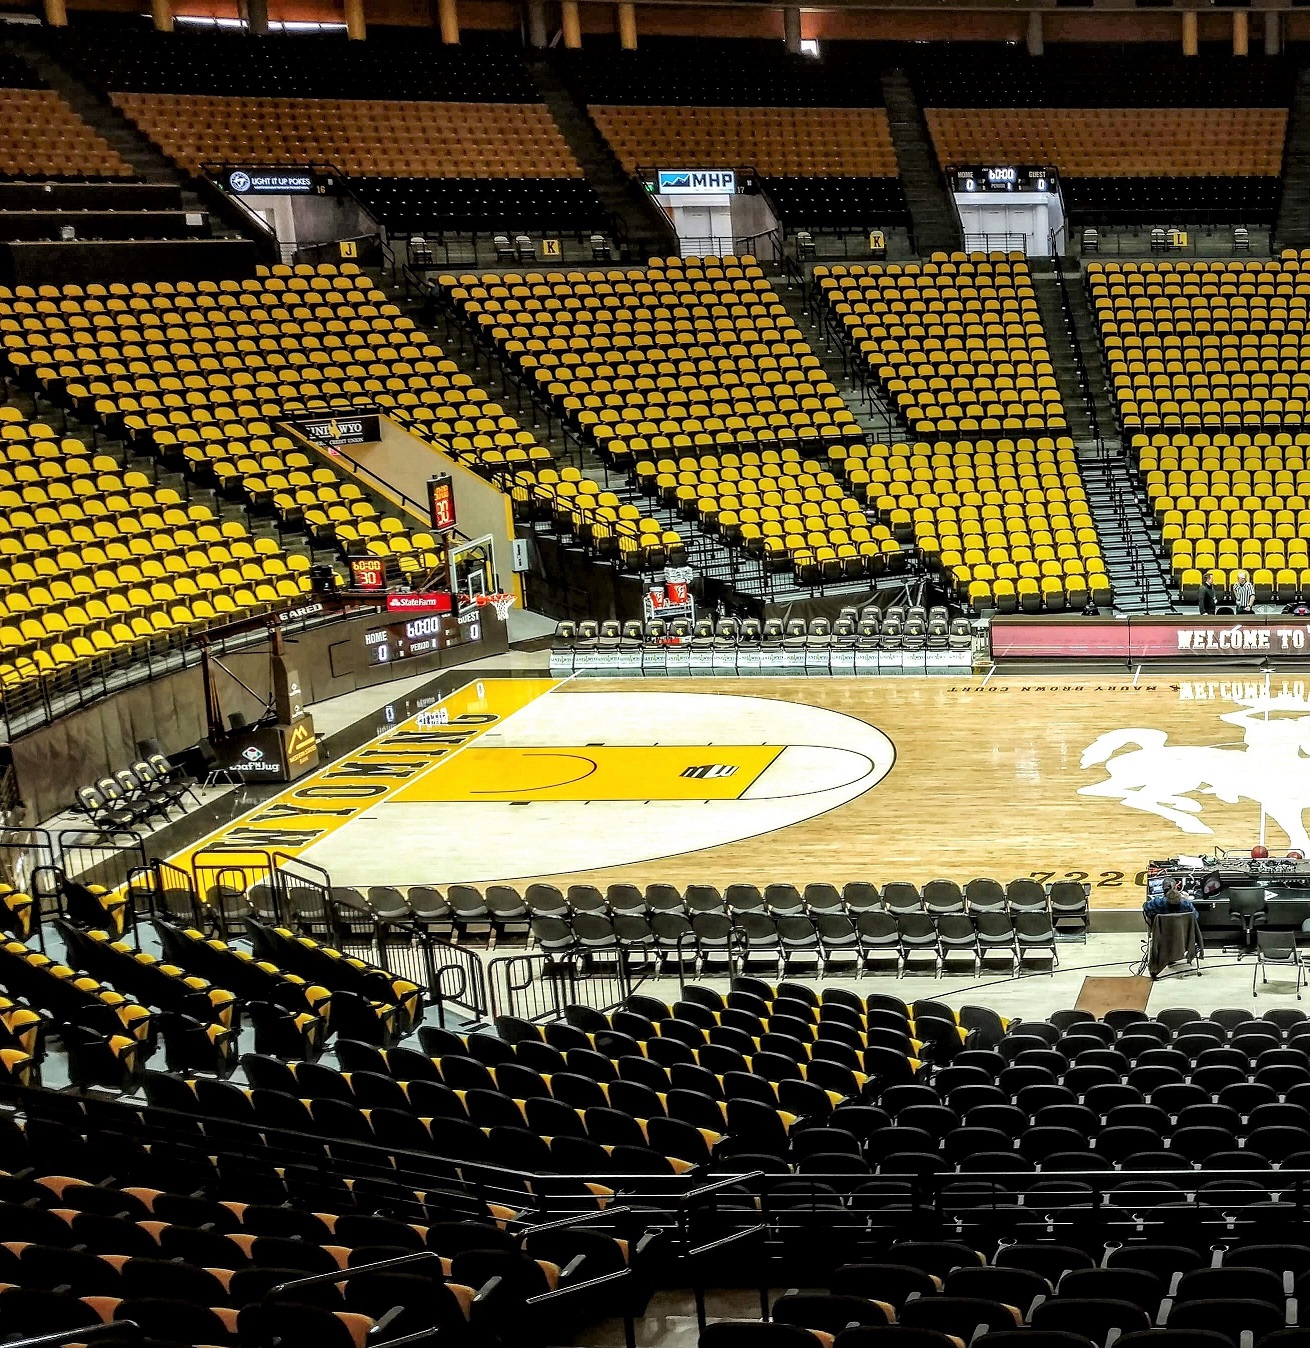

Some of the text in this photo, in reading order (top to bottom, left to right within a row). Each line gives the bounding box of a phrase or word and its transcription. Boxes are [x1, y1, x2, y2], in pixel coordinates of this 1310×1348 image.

[692, 173, 732, 187] MHP
[966, 179, 1046, 190] 0 0
[317, 185, 326, 194] 16
[737, 186, 745, 194] 17
[873, 236, 882, 247] K
[1177, 234, 1184, 244] L
[345, 243, 352, 256] J
[547, 242, 556, 253] K
[338, 423, 363, 433] WYO
[361, 572, 376, 584] 30
[279, 603, 323, 620] GARED
[365, 631, 388, 645] HOME
[378, 624, 479, 660] 0 0
[1177, 629, 1271, 649] WELCOME
[1277, 630, 1305, 649] TO
[410, 641, 430, 651] PERIOD
[201, 713, 502, 852] WYOMING
